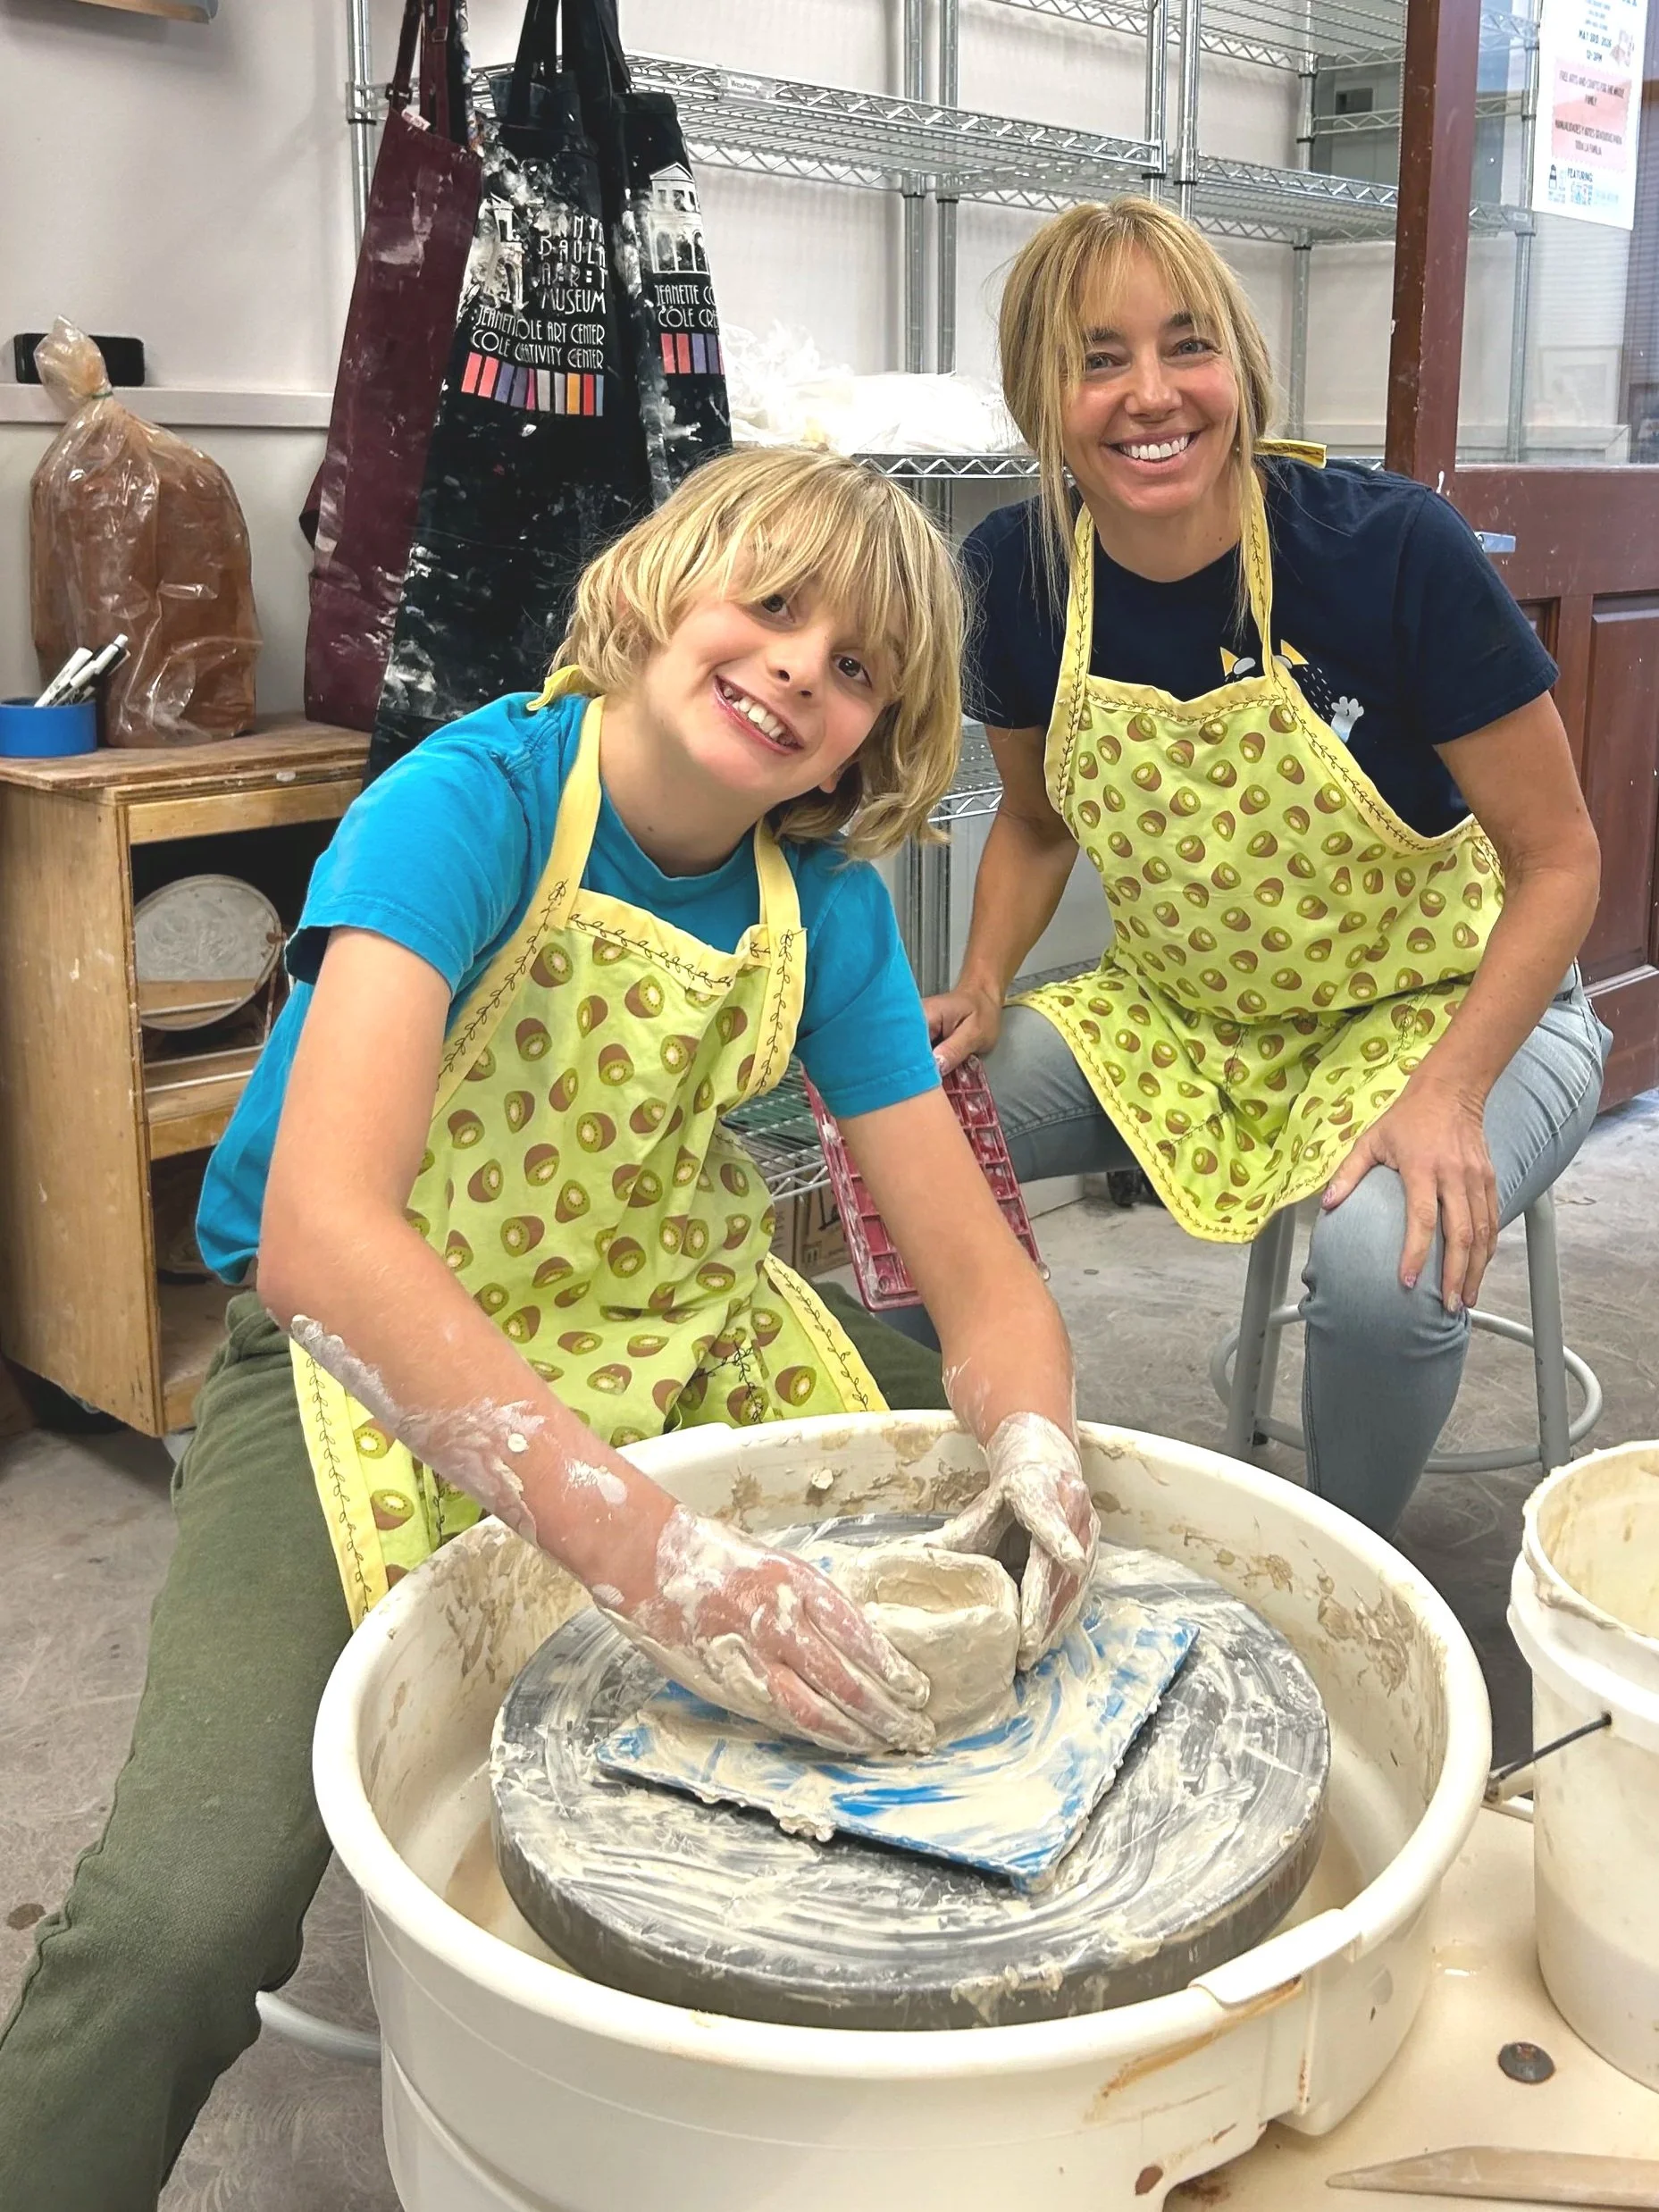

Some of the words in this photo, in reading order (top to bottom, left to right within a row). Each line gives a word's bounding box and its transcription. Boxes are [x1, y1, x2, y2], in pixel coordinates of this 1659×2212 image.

[539, 239, 607, 268] PAULA
[541, 289, 607, 314] MUSEUM
[654, 284, 700, 307] JEANETTE
[658, 307, 695, 328] COLE
[547, 321, 567, 343] ART
[570, 323, 606, 346] CENTER
[472, 329, 512, 357] COLE
[567, 347, 605, 370] CENTER
